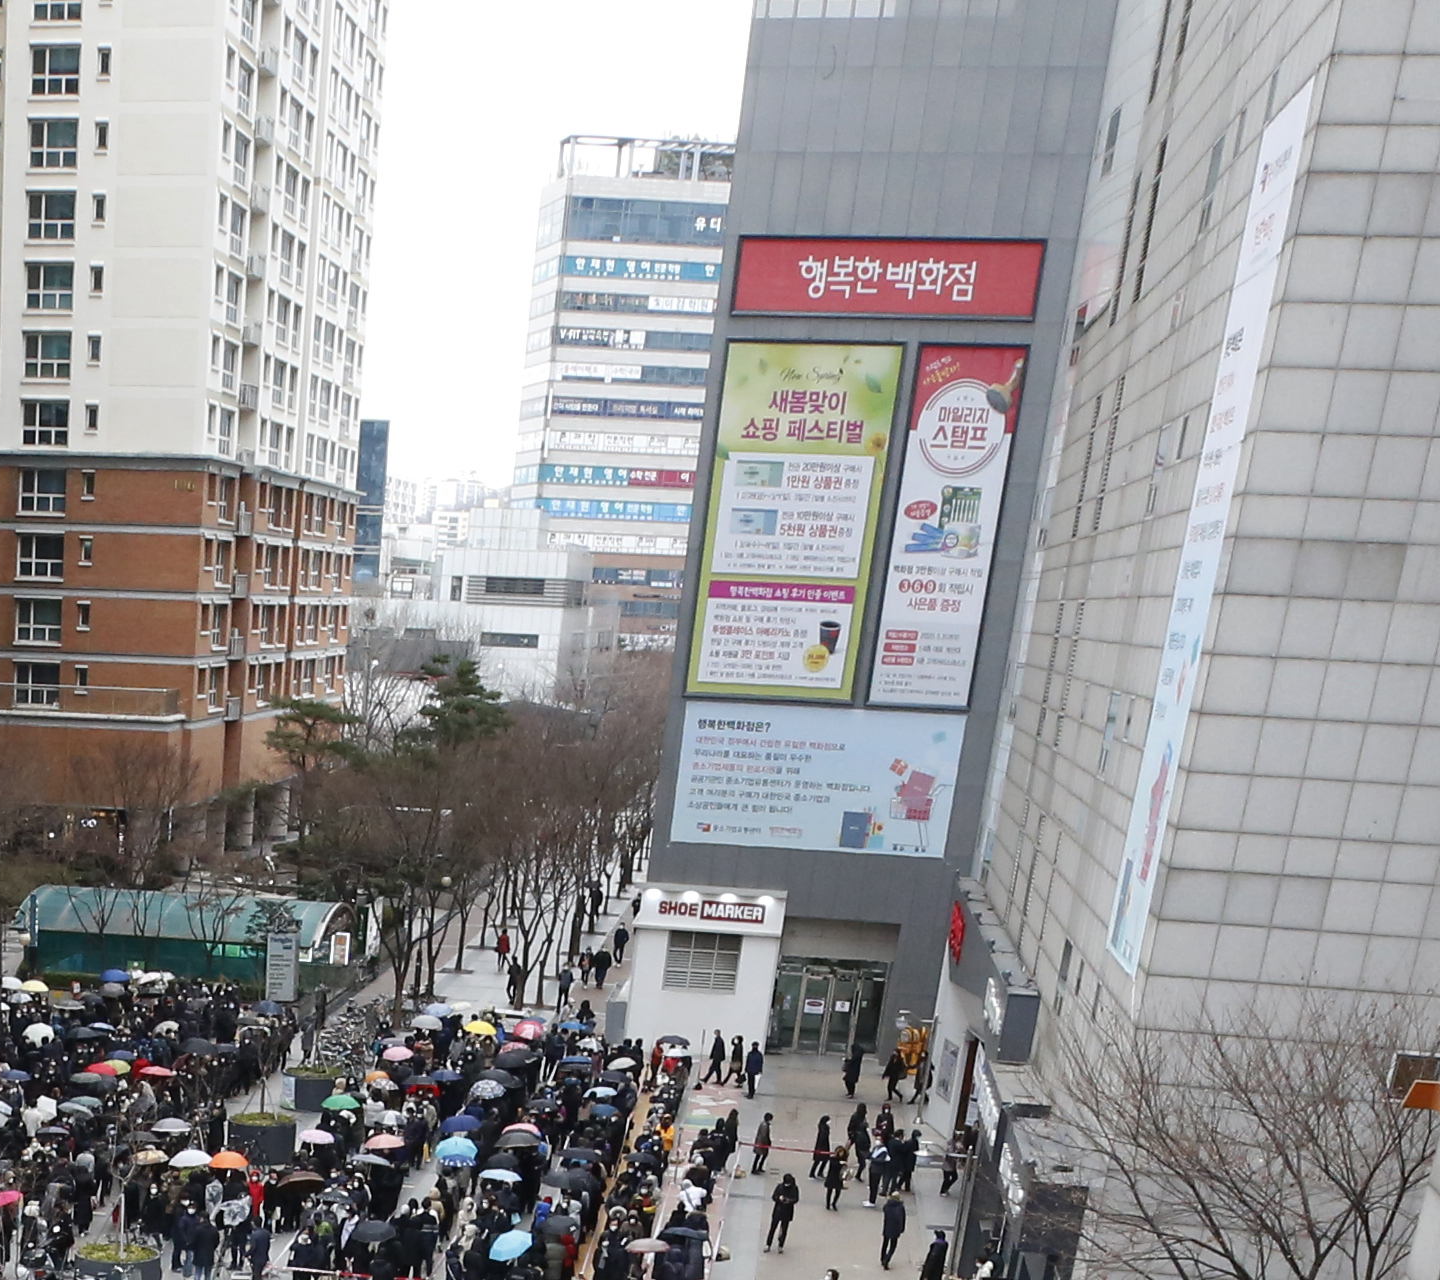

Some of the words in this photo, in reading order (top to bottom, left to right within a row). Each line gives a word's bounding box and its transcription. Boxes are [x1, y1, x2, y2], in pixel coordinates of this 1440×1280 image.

[627, 261, 651, 272] 영어
[799, 255, 883, 299] 행복한
[886, 258, 977, 301] 백화점
[780, 368, 801, 381] New
[806, 367, 843, 385] Spring
[769, 390, 847, 415] 새봄맞이
[938, 406, 990, 424] 마일리지
[741, 418, 780, 441] 쇼핑
[787, 419, 864, 444] 페스티벌
[930, 425, 988, 450] 스탬프
[604, 468, 627, 479] 영어
[802, 462, 841, 473] 20만원이상
[787, 475, 811, 489] 1만원
[814, 476, 842, 489] 상품권
[796, 511, 834, 521] 10만원이상
[780, 524, 806, 536] 5천원
[809, 525, 838, 538] 상품권
[907, 597, 937, 612] 사은품
[940, 599, 961, 612] 증정
[756, 627, 791, 637] 아메리카노
[697, 719, 771, 733] 행복한백화점은?
[658, 901, 698, 917] SHOE
[703, 902, 764, 921] MARKER
